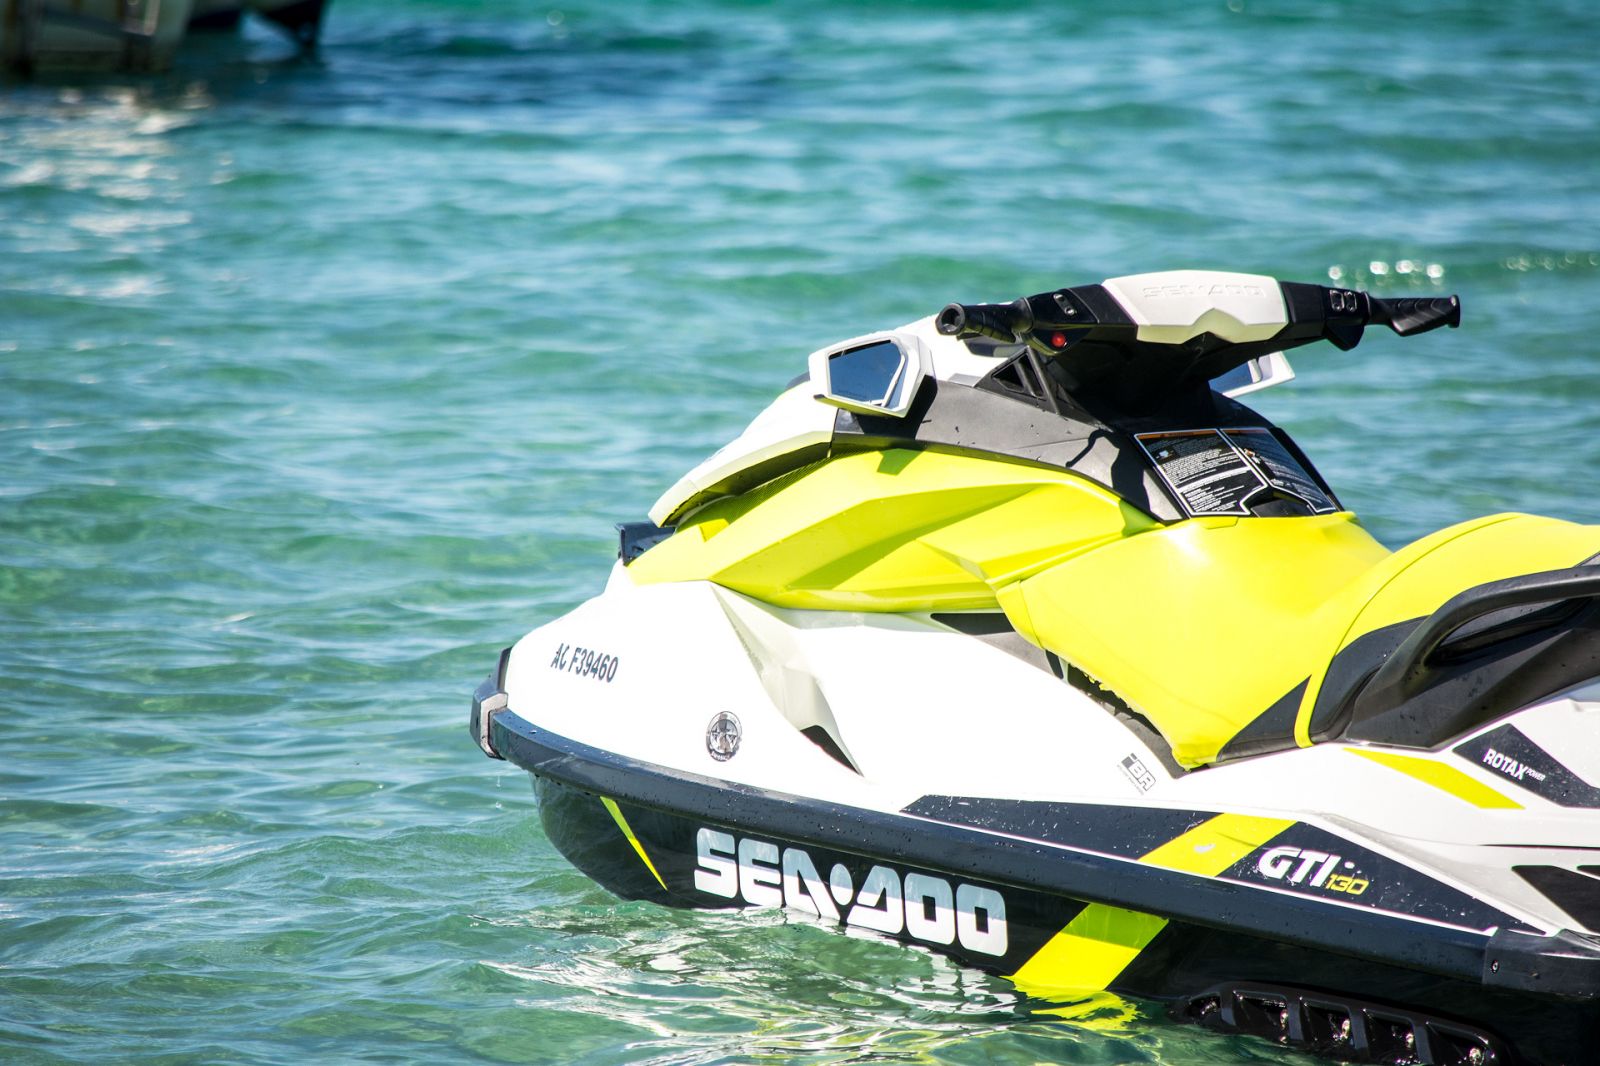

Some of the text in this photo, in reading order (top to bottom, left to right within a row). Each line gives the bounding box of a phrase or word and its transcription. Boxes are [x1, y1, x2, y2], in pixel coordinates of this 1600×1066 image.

[550, 643, 619, 683] AC F39460
[1482, 748, 1528, 780] ROTAX
[1258, 845, 1370, 895] GTI 130
